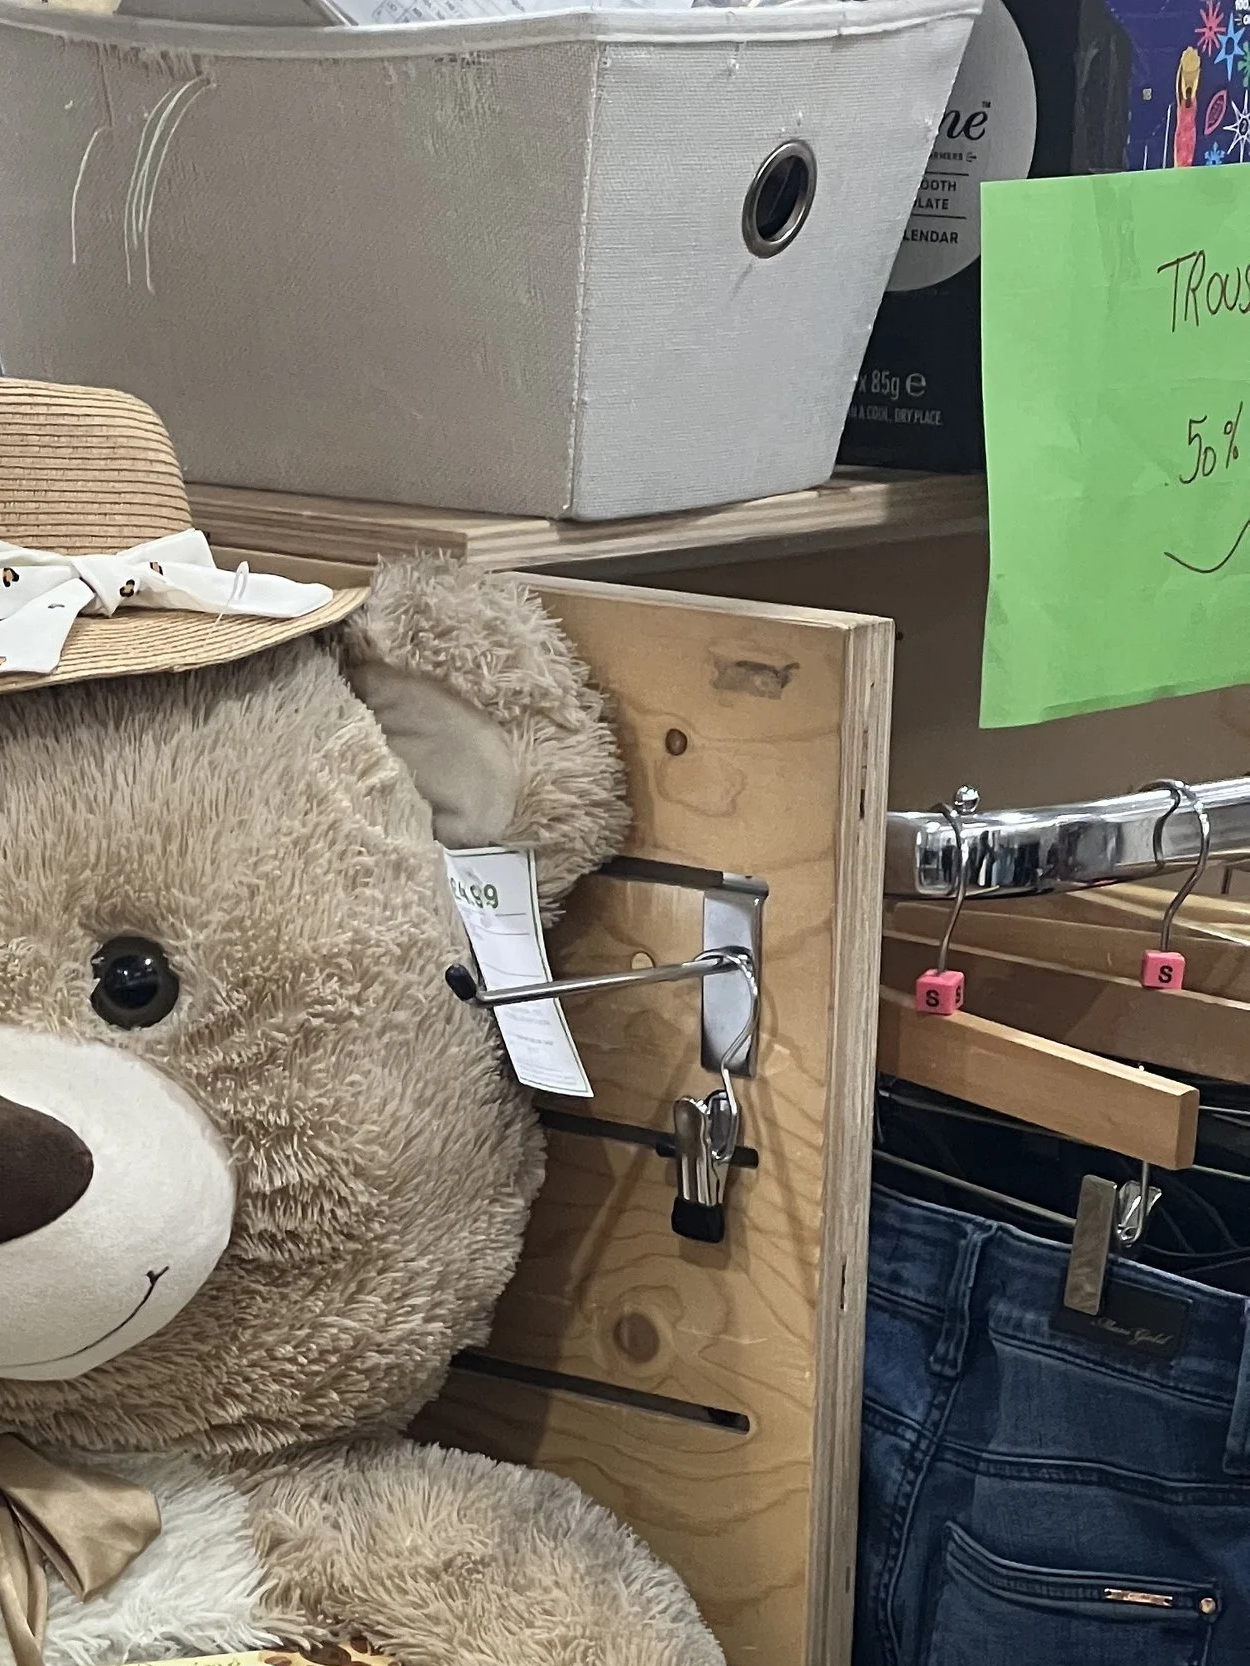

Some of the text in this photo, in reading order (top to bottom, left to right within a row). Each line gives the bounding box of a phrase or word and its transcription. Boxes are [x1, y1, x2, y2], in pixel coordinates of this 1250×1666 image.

[871, 369, 900, 400] 85g
[1179, 401, 1244, 484] 50%
[1158, 965, 1173, 984] S
[925, 989, 940, 1008] S
